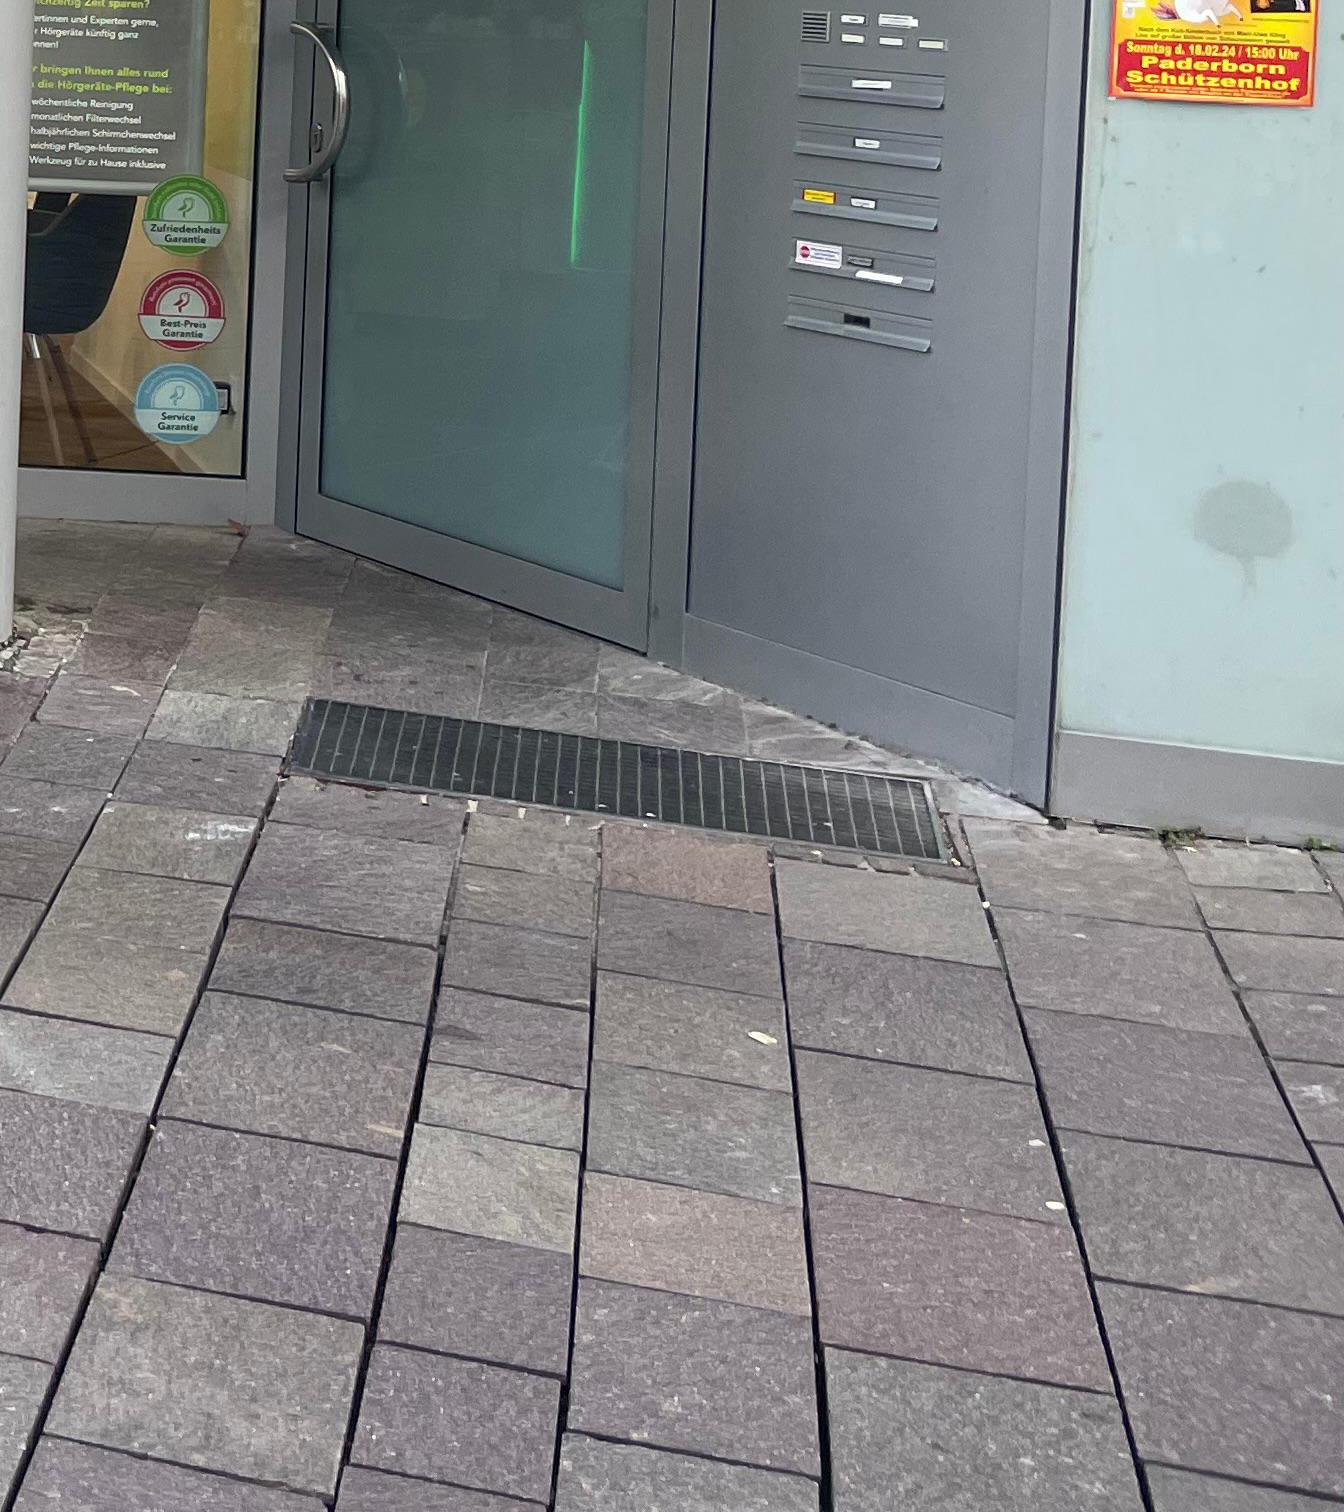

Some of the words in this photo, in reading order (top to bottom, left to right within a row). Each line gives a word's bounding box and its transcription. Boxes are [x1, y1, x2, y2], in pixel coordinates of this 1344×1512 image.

[108, 0, 151, 10] sparen?
[70, 15, 88, 24] und
[90, 16, 129, 27] Experten
[40, 26, 84, 39] Hörgeräte
[85, 28, 116, 40] künftig
[118, 31, 140, 40] ganz
[1126, 41, 1172, 57] Sonntag
[1174, 43, 1185, 55] d.
[1188, 44, 1236, 59] 18.02.24
[1246, 46, 1275, 60] 15:00
[1278, 47, 1300, 61] Uhr
[40, 64, 82, 77] bringen
[84, 65, 114, 76] Ihnen
[116, 67, 141, 77] alles
[143, 68, 169, 78] rund
[1141, 55, 1286, 75] Paderborn
[38, 80, 54, 89] die
[57, 80, 150, 95] Hörgeräte-Pflege
[1125, 70, 1301, 92] Schützenhof
[31, 97, 88, 108] wöchentliche
[90, 99, 134, 112] Reinigung
[29, 155, 72, 167] Werkzeug
[74, 157, 86, 166] für
[100, 159, 128, 168] Hause
[164, 233, 207, 245] Garantie
[160, 319, 207, 329] Best-Preis
[162, 328, 204, 339] Garantie
[161, 411, 196, 422] Service
[157, 420, 199, 432] Garantie
